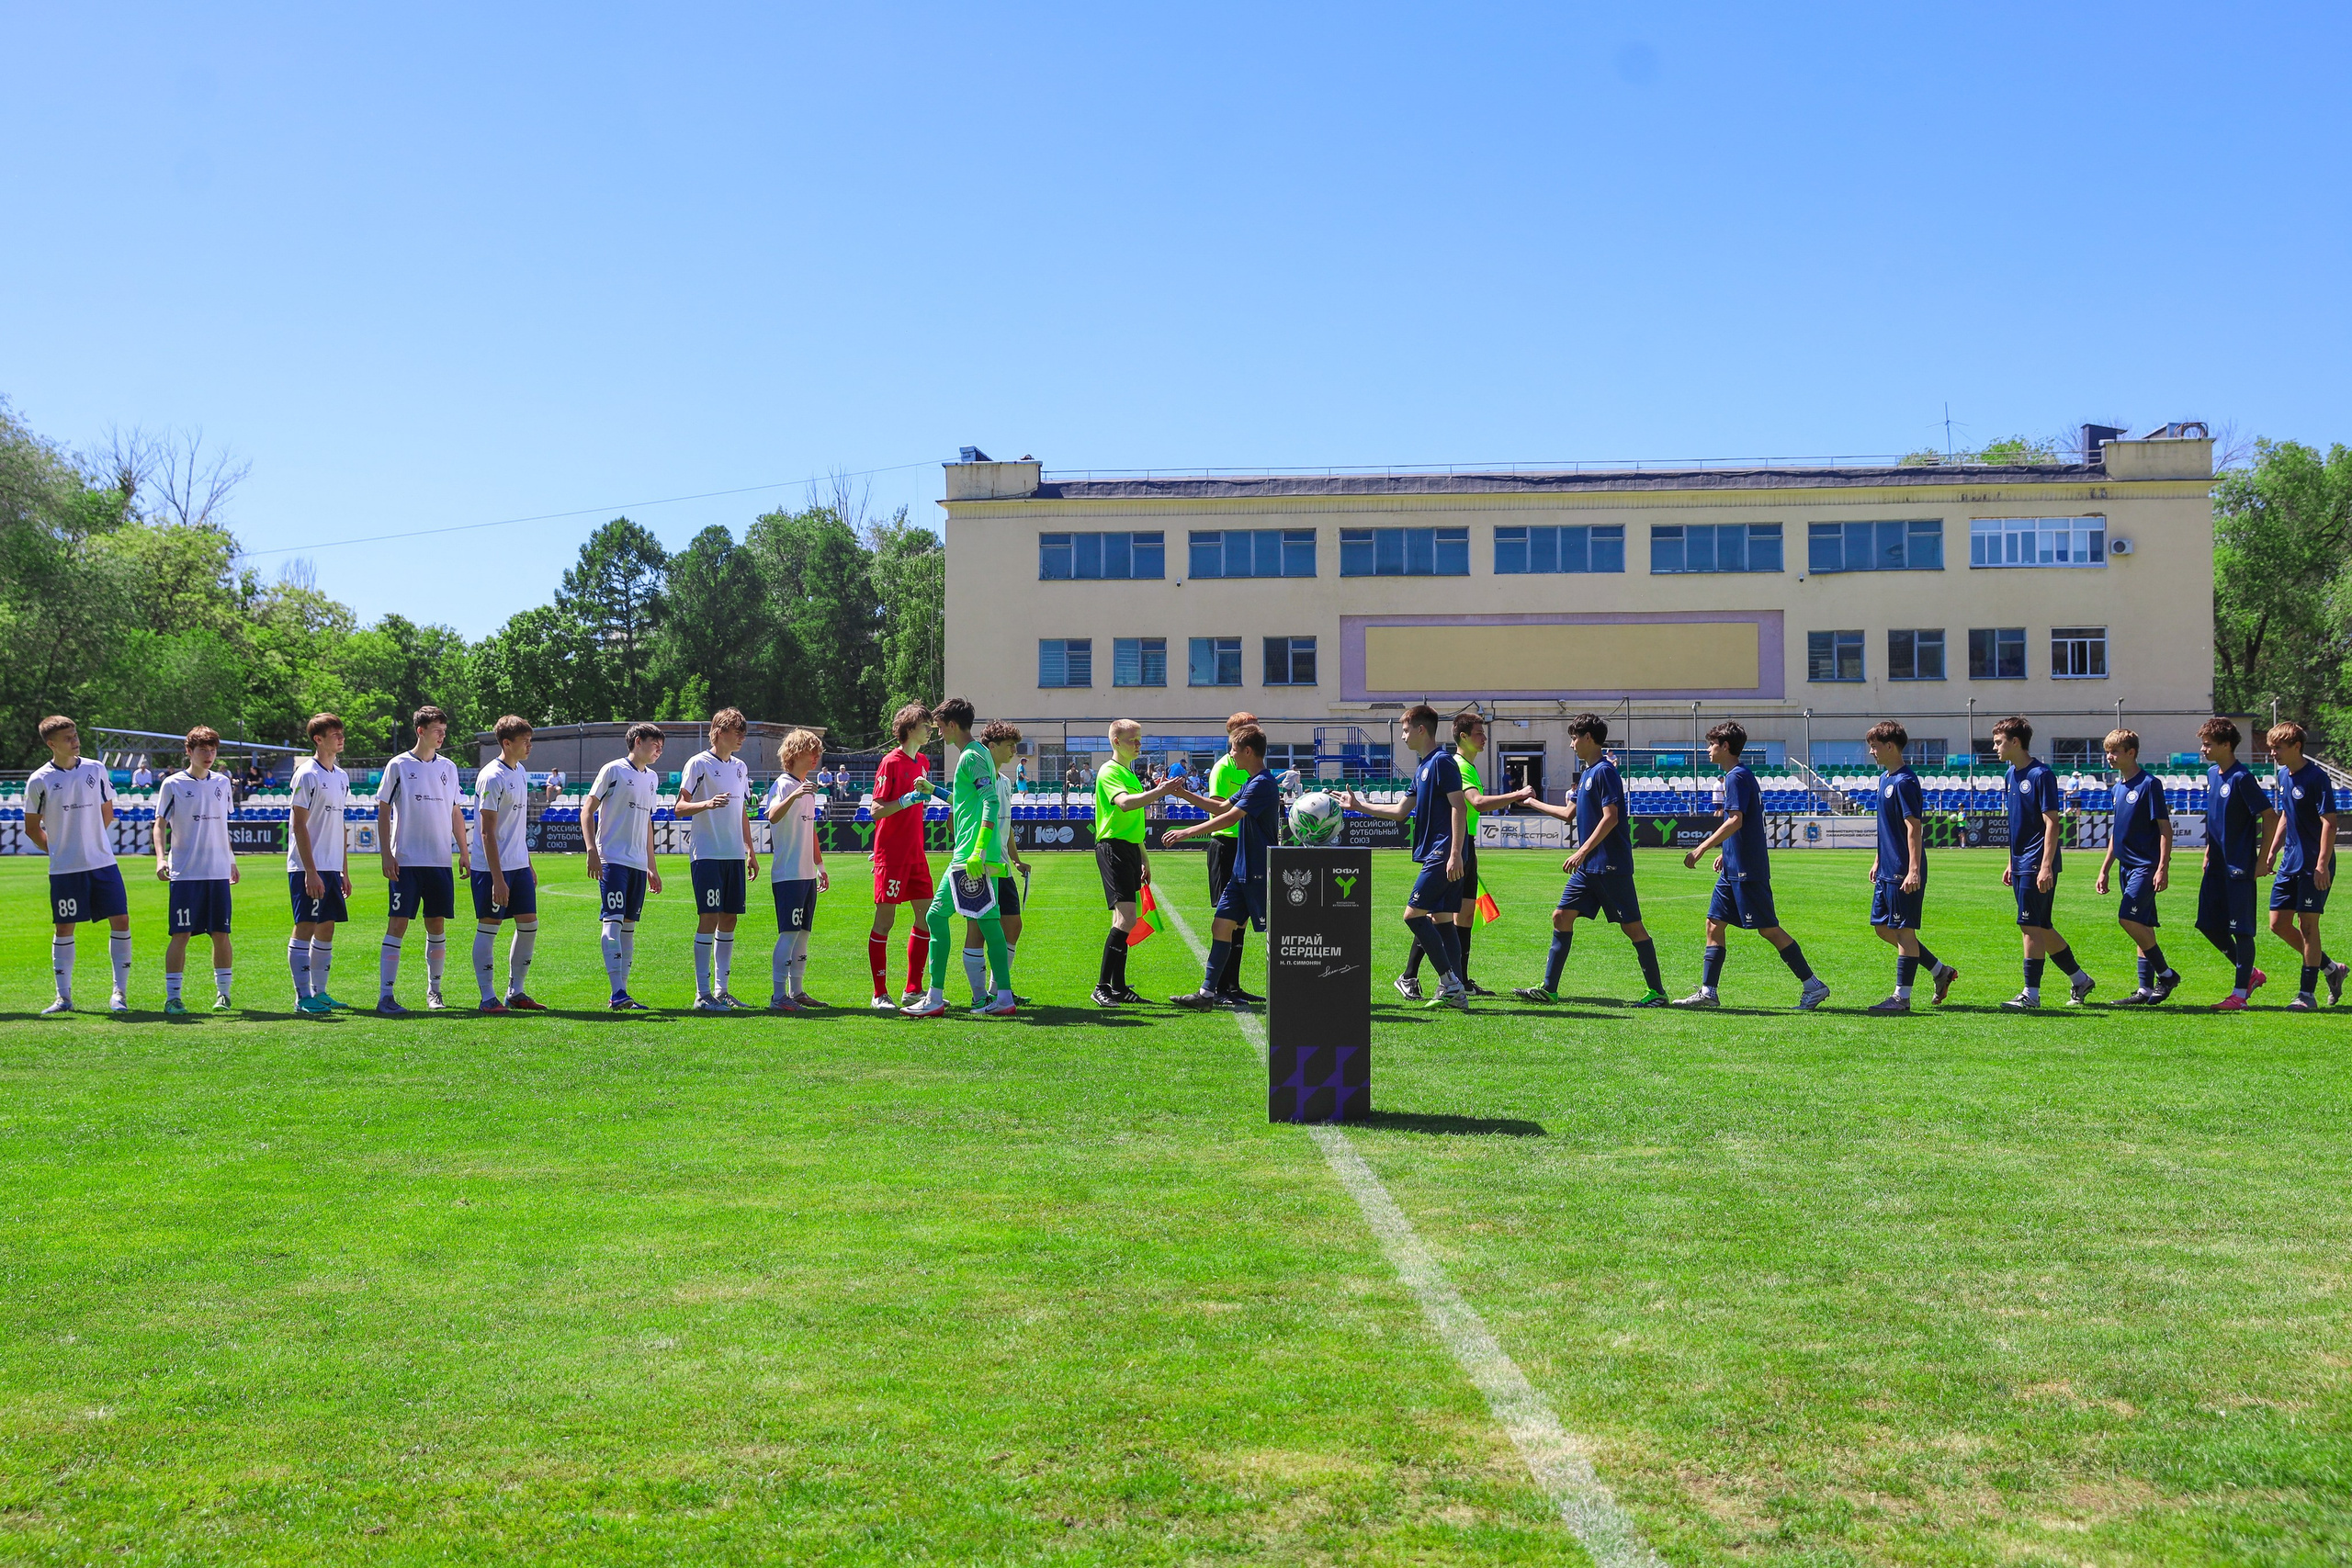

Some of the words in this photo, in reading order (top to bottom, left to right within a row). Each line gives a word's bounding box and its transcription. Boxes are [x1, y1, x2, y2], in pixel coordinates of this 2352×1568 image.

[886, 879, 901, 898] 35
[392, 892, 401, 911] 3
[607, 891, 624, 910] 69
[706, 889, 720, 907] 88
[58, 898, 77, 917] 89
[311, 899, 319, 916] 2
[176, 908, 191, 926] 11
[1281, 933, 1323, 945] ИГРАЙ
[1280, 947, 1341, 958] СЕРДЦЕМ
